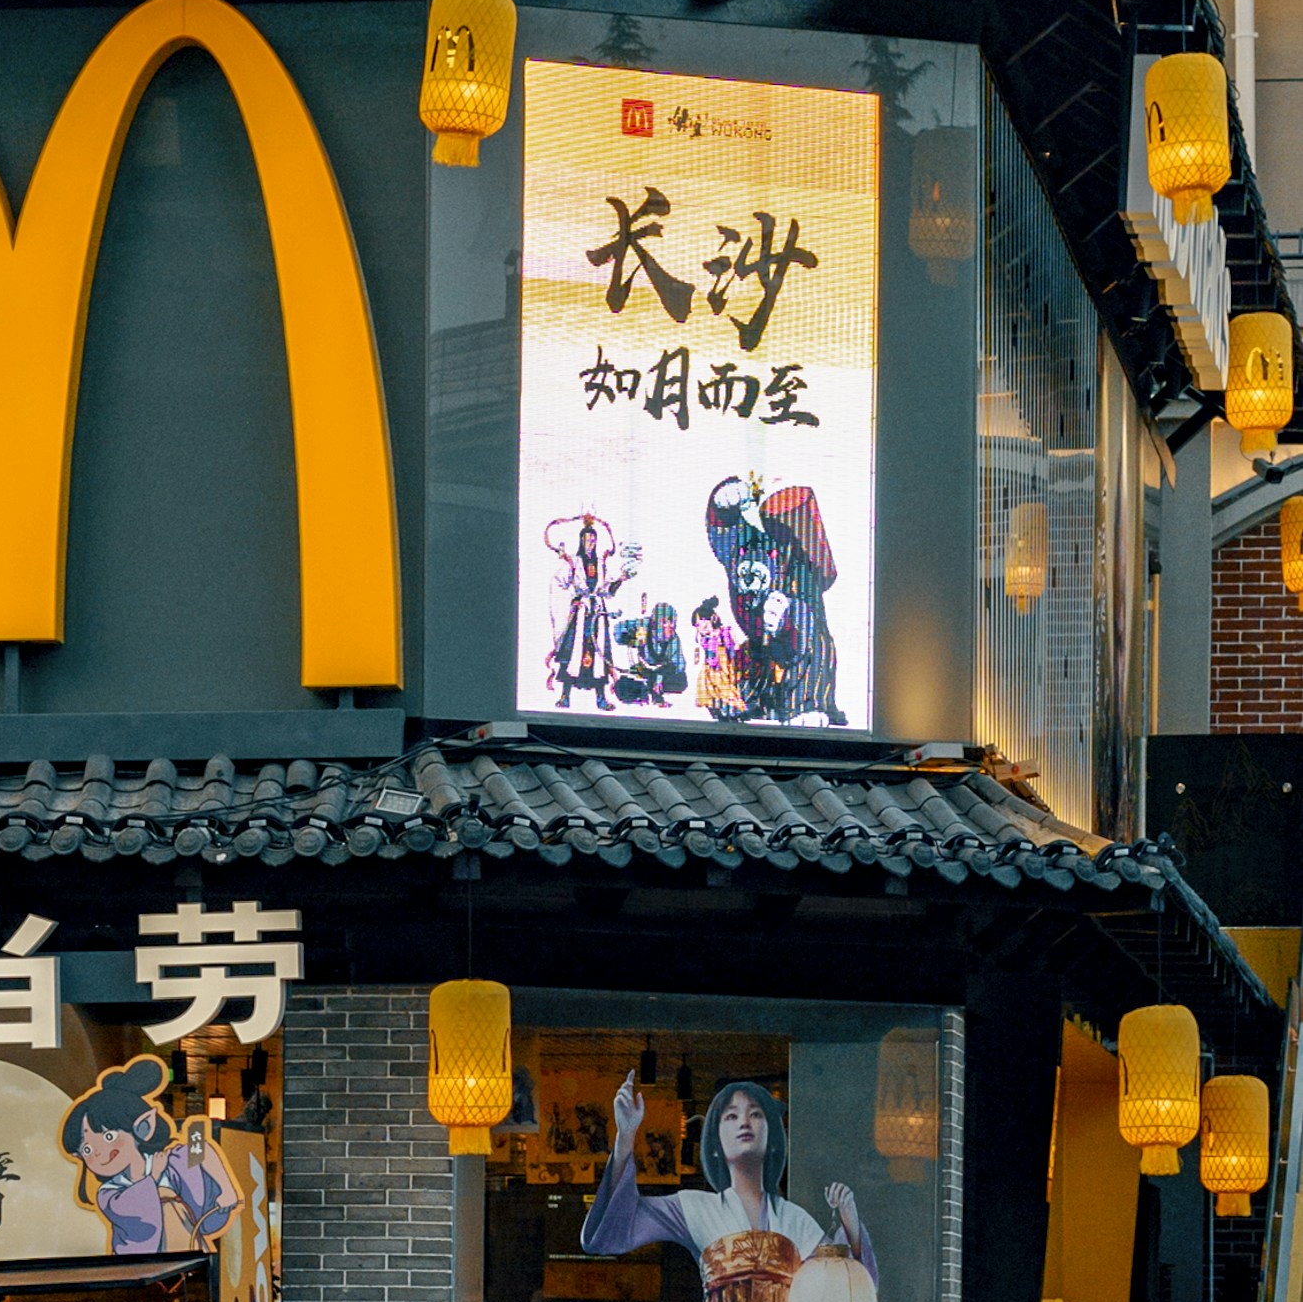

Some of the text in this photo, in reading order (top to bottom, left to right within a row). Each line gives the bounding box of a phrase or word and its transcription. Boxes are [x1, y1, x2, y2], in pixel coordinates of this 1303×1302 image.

[586, 186, 819, 352] 长沙
[579, 345, 820, 431] 如月而至
